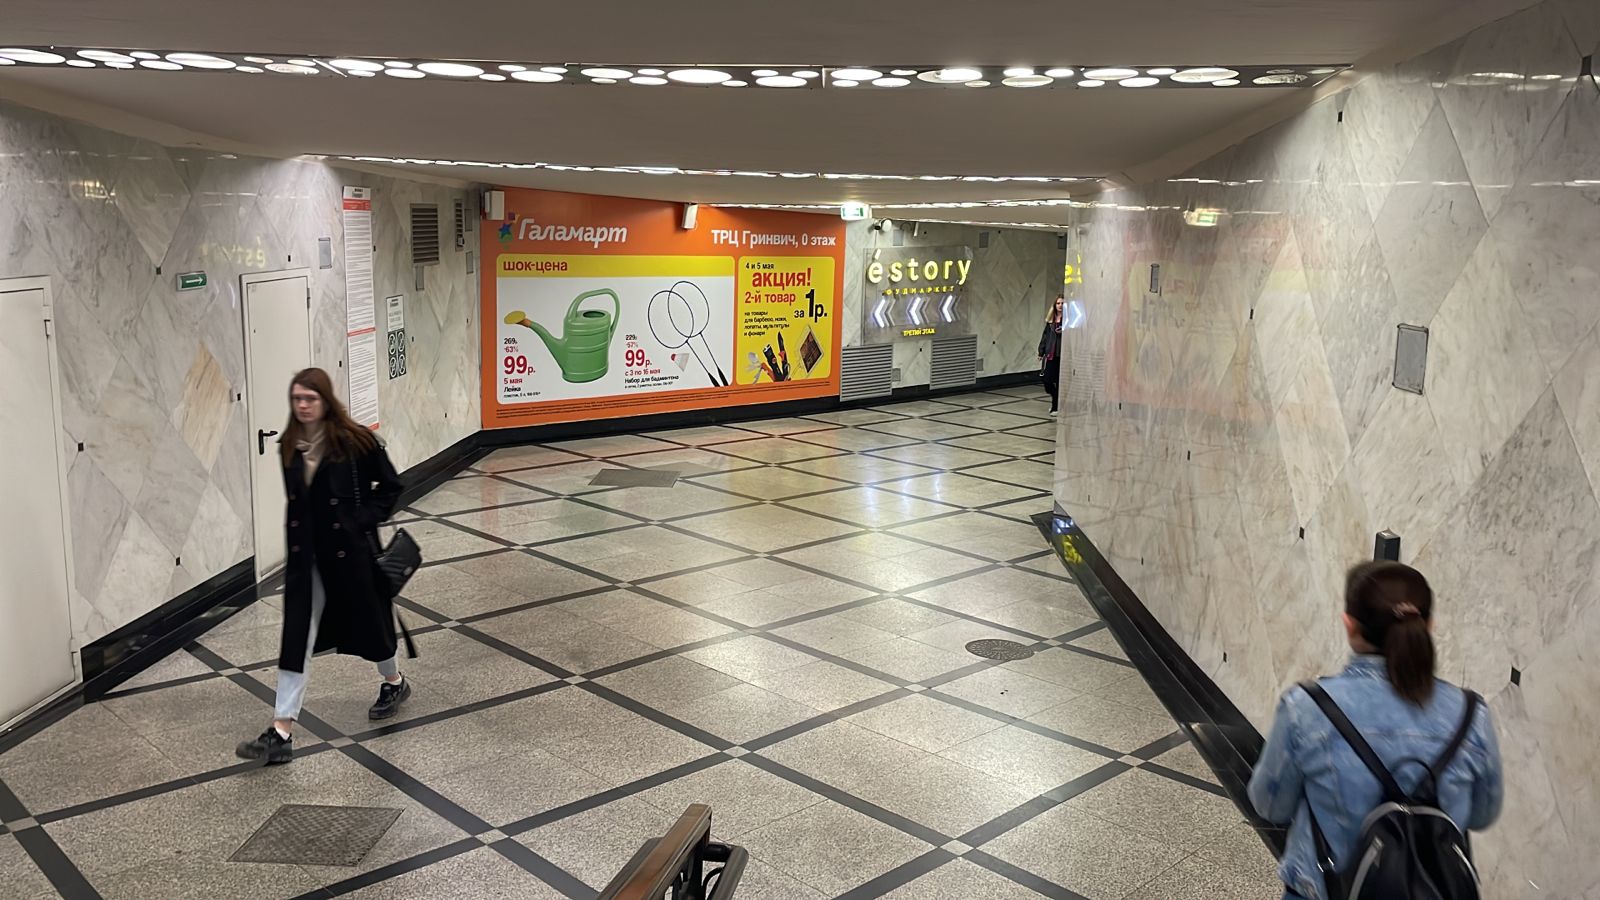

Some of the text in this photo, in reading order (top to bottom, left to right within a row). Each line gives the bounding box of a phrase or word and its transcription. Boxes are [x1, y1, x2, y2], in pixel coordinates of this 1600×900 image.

[518, 218, 628, 249] Галамарт
[711, 229, 836, 249] ТРЦ Гринвич, 0 этаж
[503, 260, 568, 273] шок-цена
[745, 262, 750, 270] 4
[756, 262, 761, 270] 5
[752, 267, 812, 291] акция!
[744, 290, 796, 306] 2-й товар
[793, 309, 805, 318] за
[503, 377, 509, 385] 5
